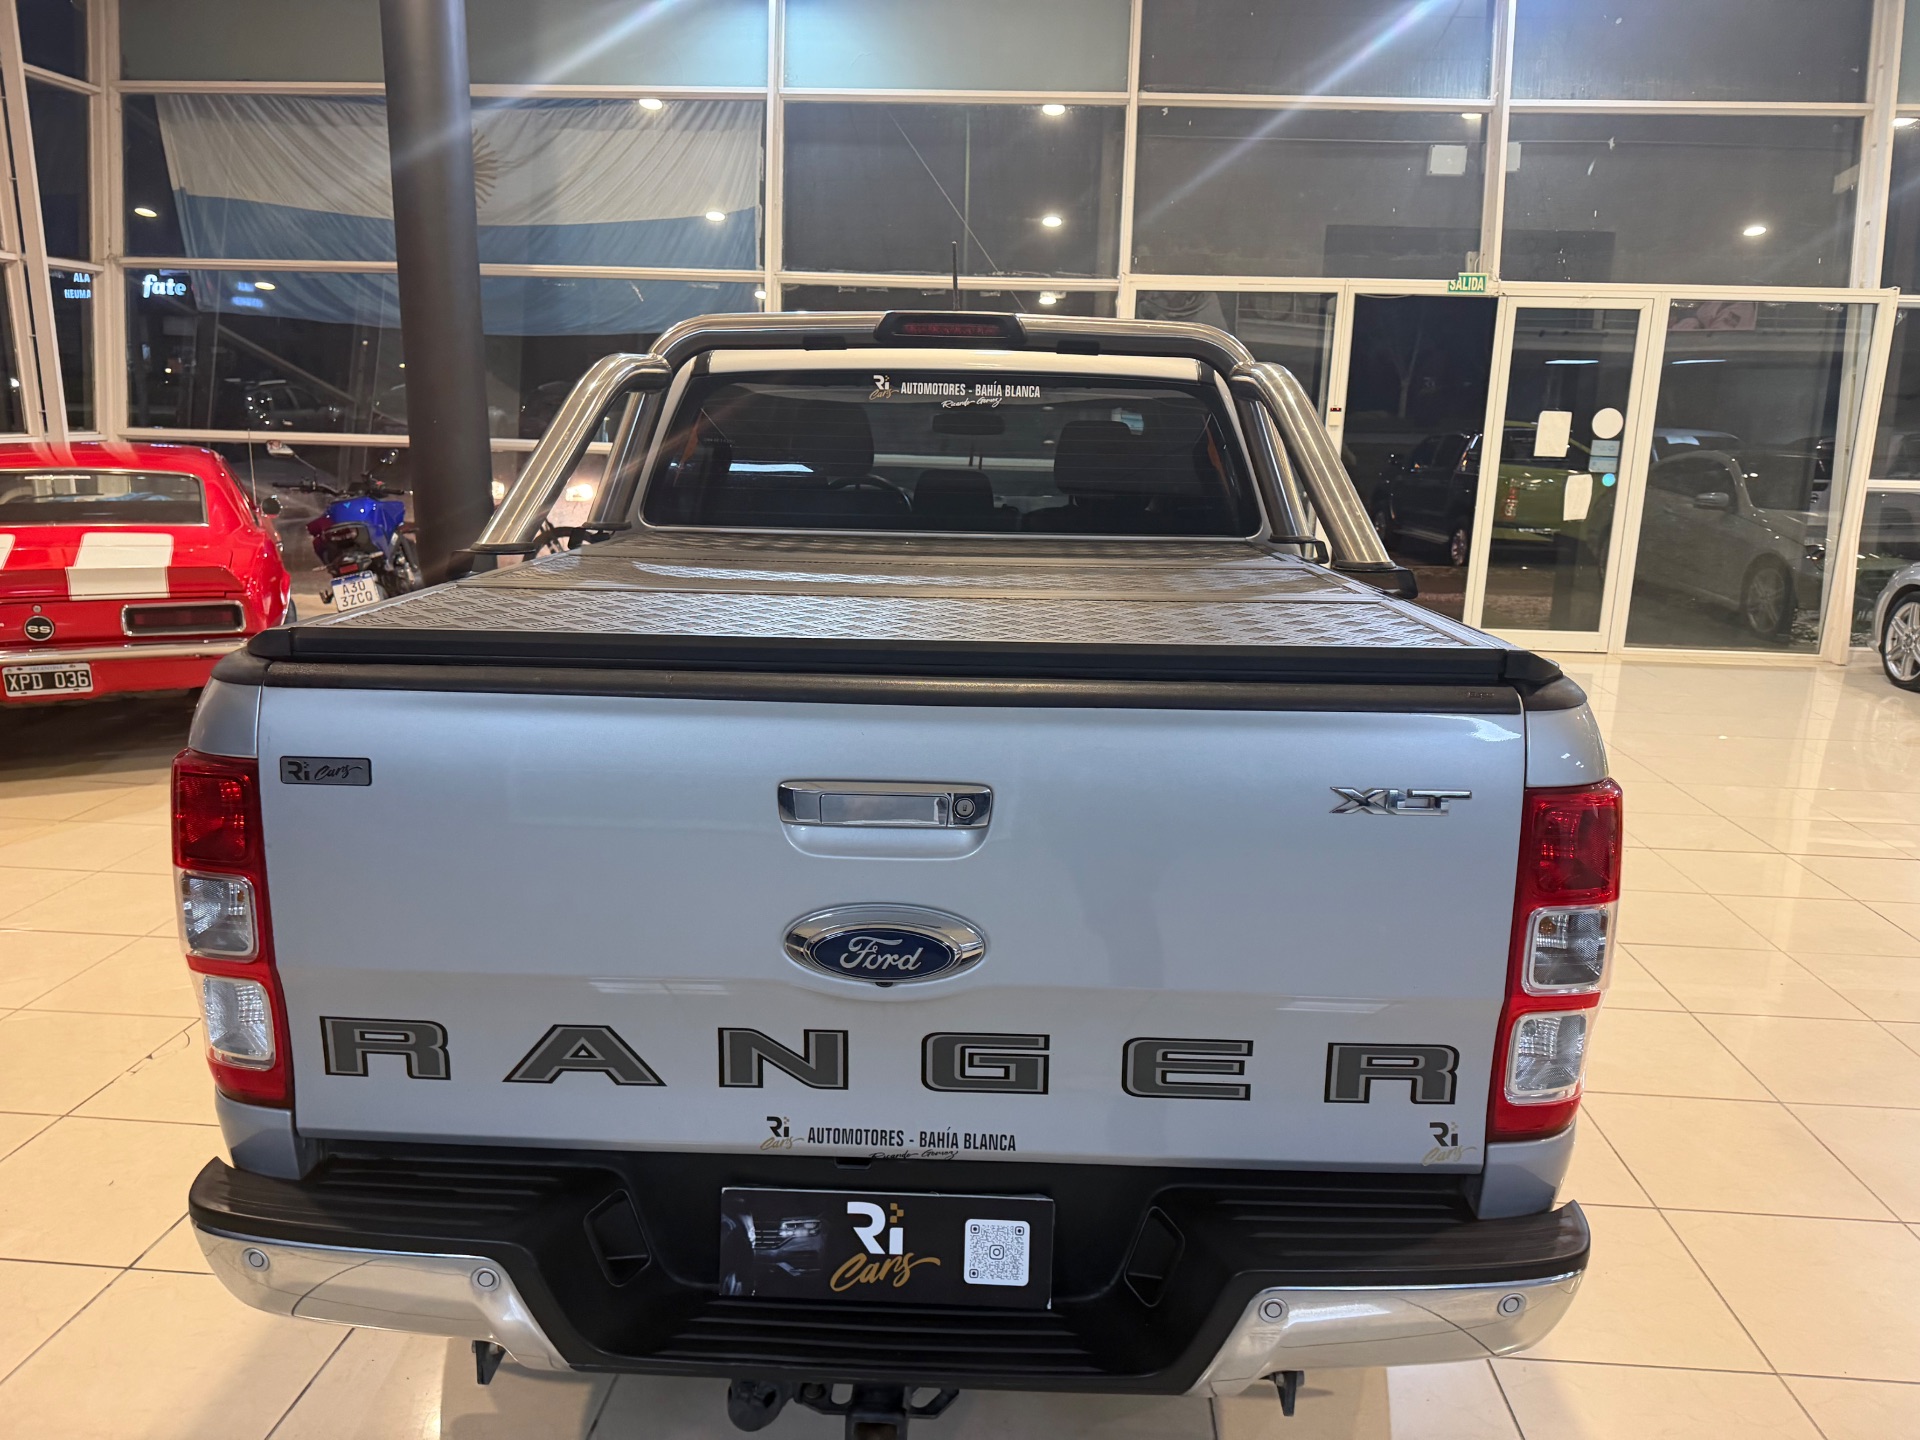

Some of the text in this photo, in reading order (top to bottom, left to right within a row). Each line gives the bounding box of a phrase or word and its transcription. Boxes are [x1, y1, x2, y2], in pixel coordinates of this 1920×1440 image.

[142, 274, 187, 298] fate
[1449, 276, 1484, 291] SALIDA
[900, 382, 966, 396] AUTOMOTORES
[975, 381, 1003, 397] BAHÍA
[1005, 385, 1041, 398] BLANCA
[27, 625, 51, 634] SS
[8, 671, 89, 691] XPD 036
[314, 765, 363, 781] Cars
[1329, 786, 1472, 815] XLT
[839, 936, 924, 971] Ford
[319, 1015, 1460, 1105] RANGER
[807, 1126, 905, 1147] AUTOMOTORES
[919, 1126, 959, 1149] BAHÍA
[963, 1132, 1017, 1152] BLANCA
[847, 1201, 904, 1255] Ri
[830, 1252, 941, 1292] Cars
